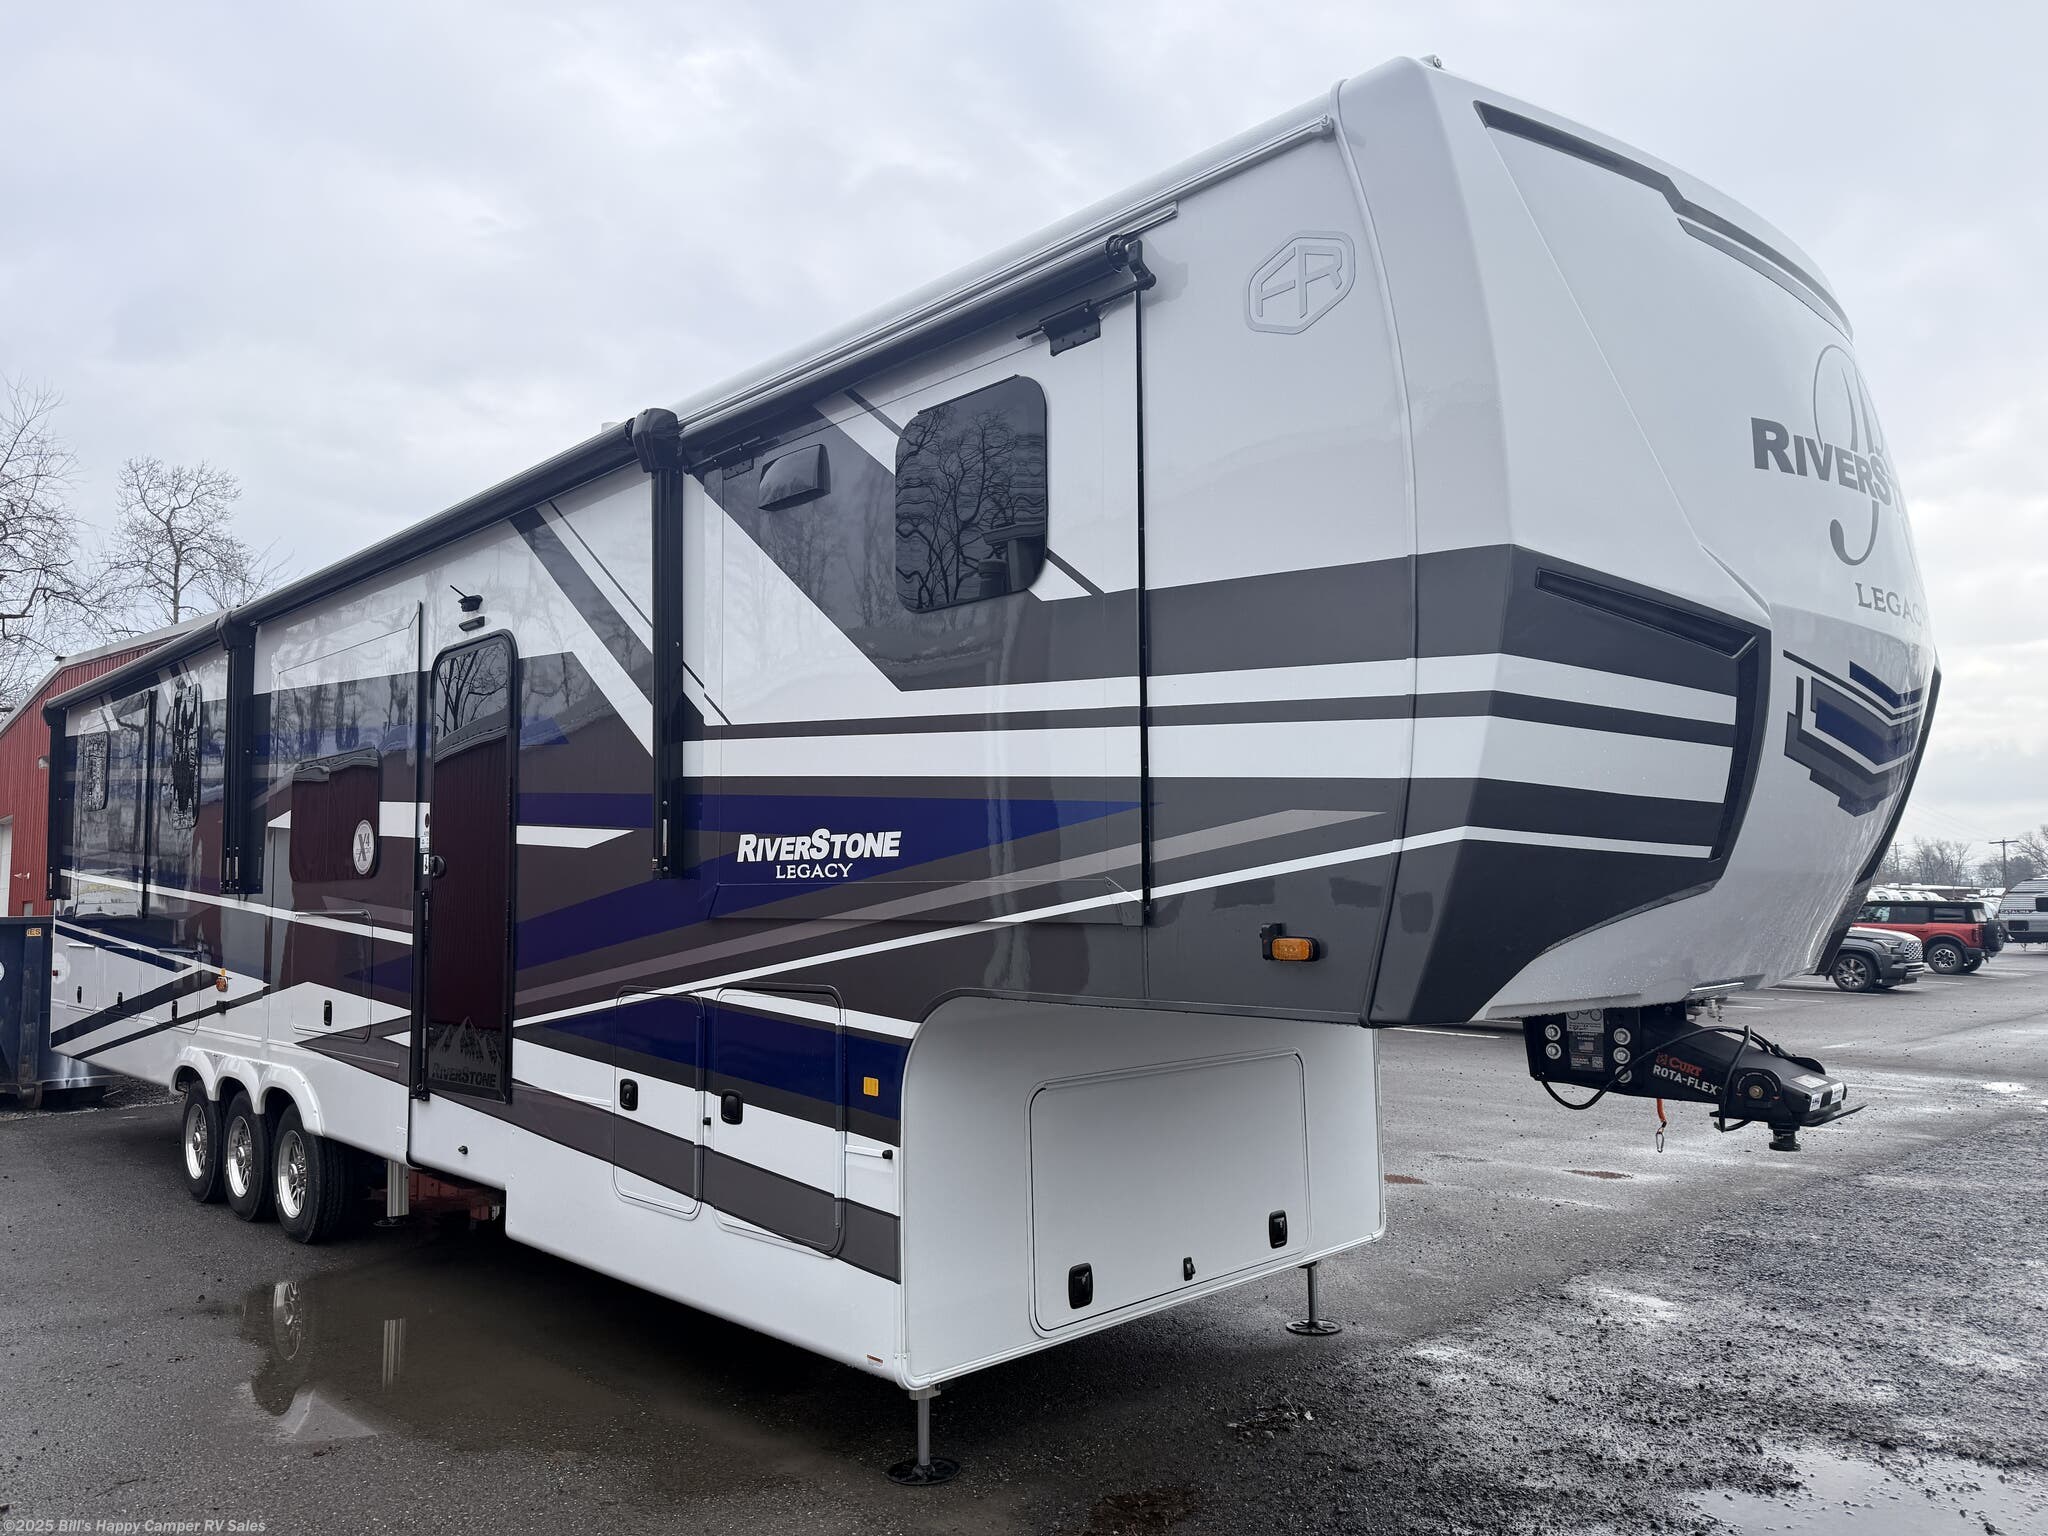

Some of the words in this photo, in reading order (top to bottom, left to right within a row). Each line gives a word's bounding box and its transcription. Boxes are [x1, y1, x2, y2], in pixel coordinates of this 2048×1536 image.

[1855, 582, 1923, 627] LEGAC
[736, 828, 902, 863] RIVERSTONE
[775, 863, 853, 879] LEGACY
[432, 1062, 497, 1089] RIVERSTONE
[1669, 1057, 1702, 1077] CURT
